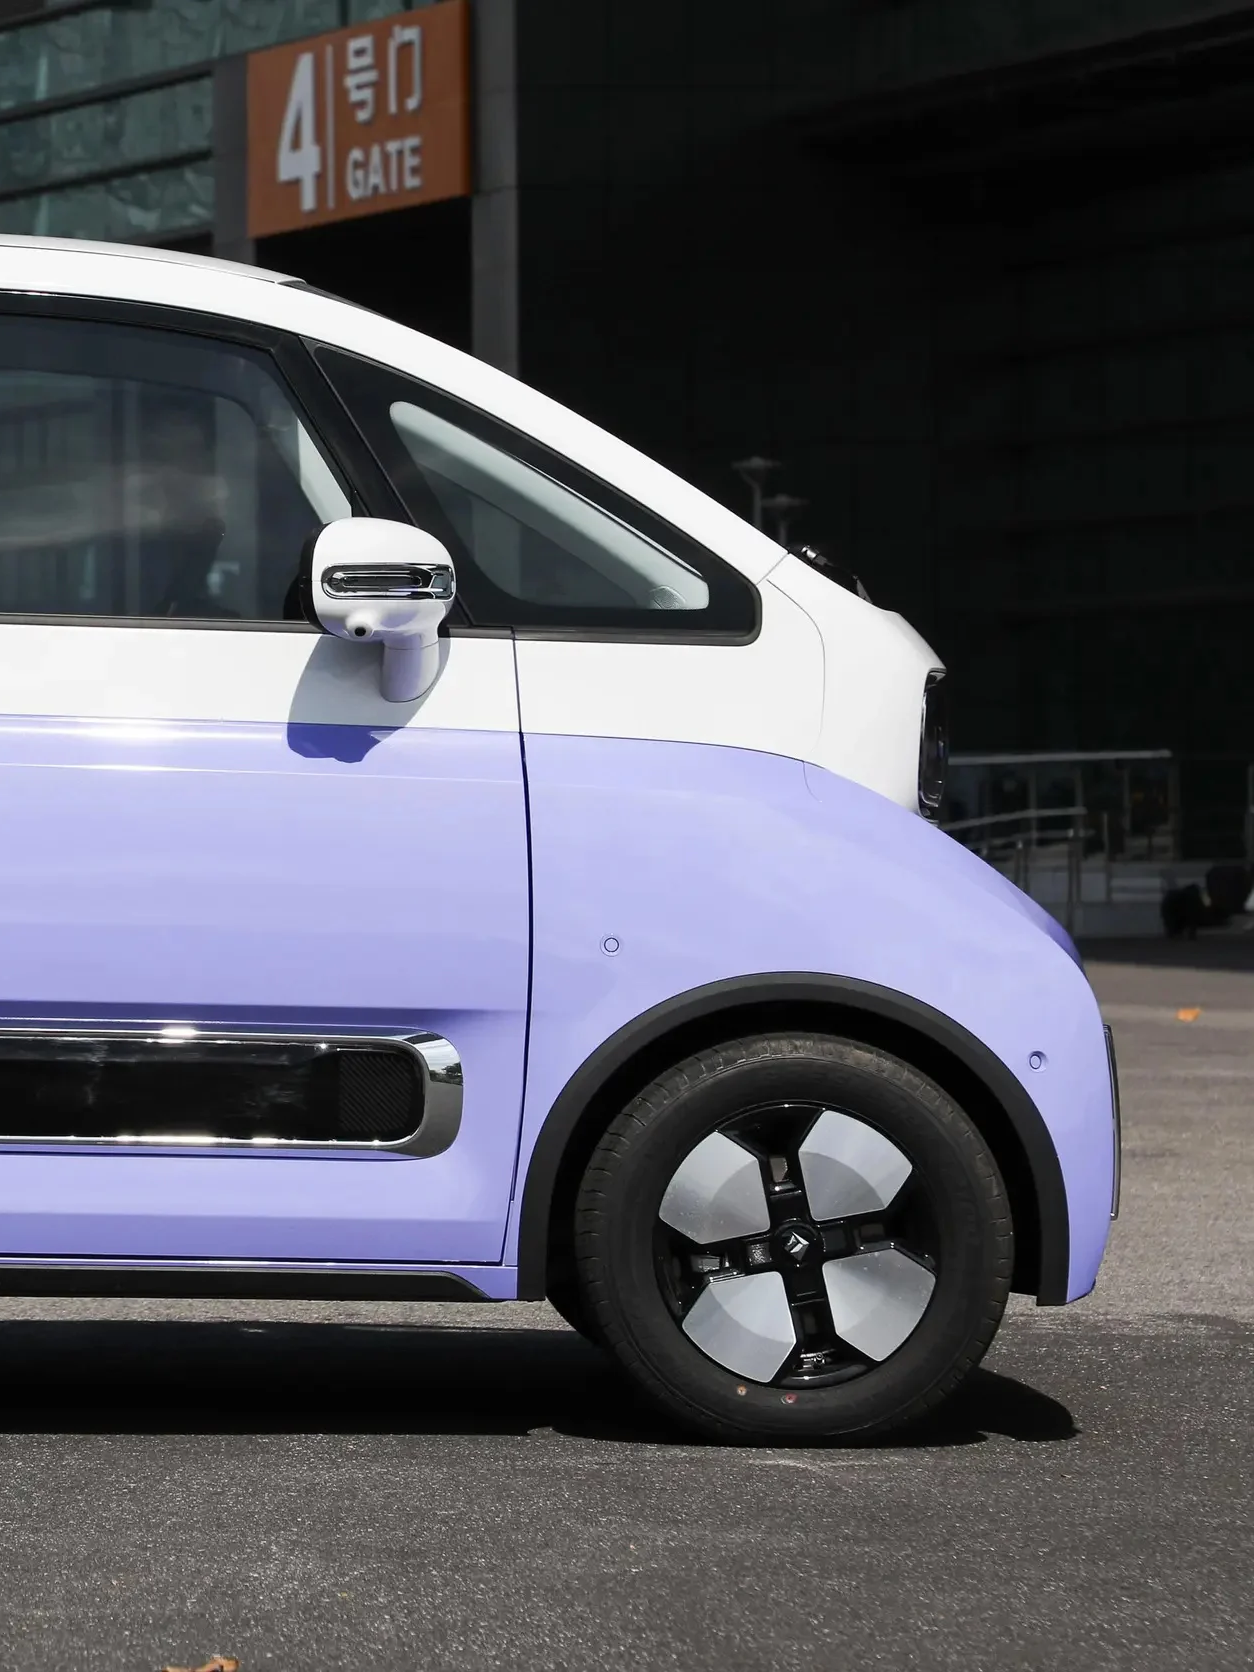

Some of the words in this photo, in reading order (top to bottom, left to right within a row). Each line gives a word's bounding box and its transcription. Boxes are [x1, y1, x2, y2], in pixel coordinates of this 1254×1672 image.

[343, 25, 423, 124] 号门
[276, 51, 322, 213] 4
[347, 135, 423, 201] GATE
